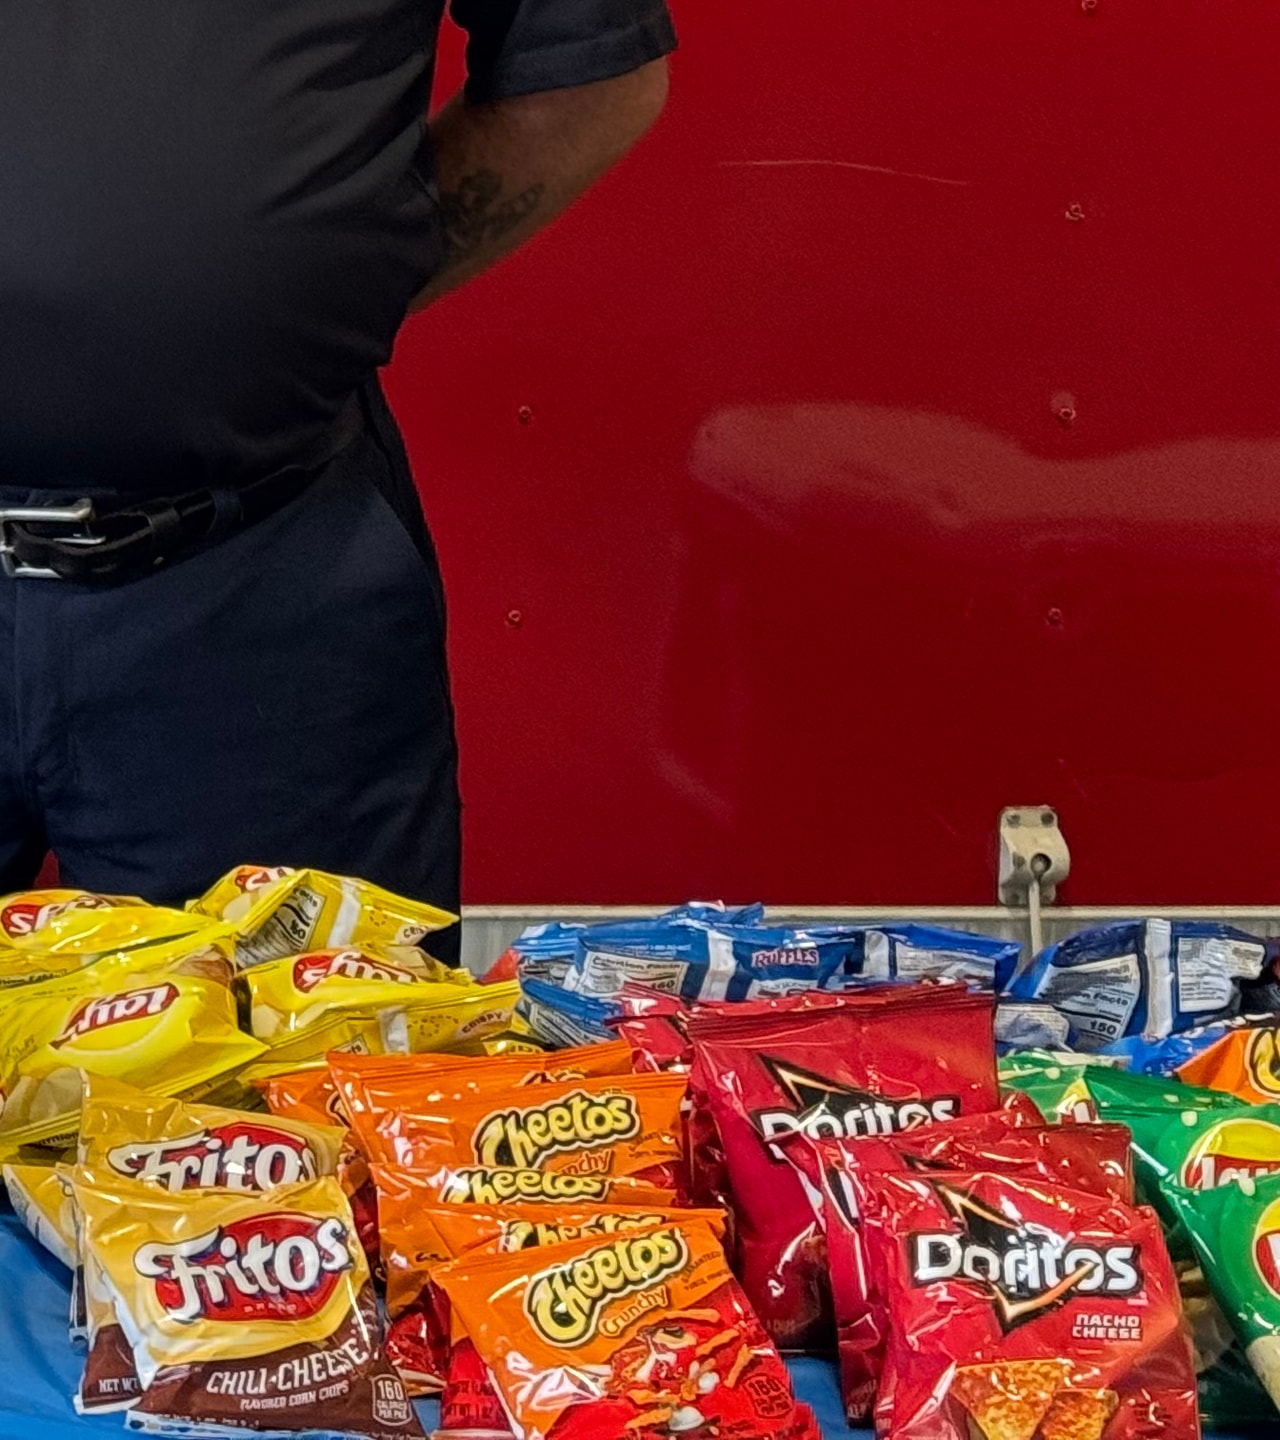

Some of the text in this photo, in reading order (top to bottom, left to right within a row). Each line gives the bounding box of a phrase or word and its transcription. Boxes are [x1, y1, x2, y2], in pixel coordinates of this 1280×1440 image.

[753, 948, 819, 967] RUFFLES
[1090, 1020, 1118, 1036] 150
[479, 1095, 634, 1168] Cheetos
[133, 1217, 351, 1323] Fritos
[915, 1233, 1139, 1293] Doritos
[530, 1228, 681, 1342] Cheetos
[598, 1284, 669, 1337] Crunchy
[1075, 1314, 1141, 1328] NACHO
[1071, 1326, 1141, 1340] CHEESE
[99, 1378, 120, 1393] NET
[377, 1380, 405, 1400] 160
